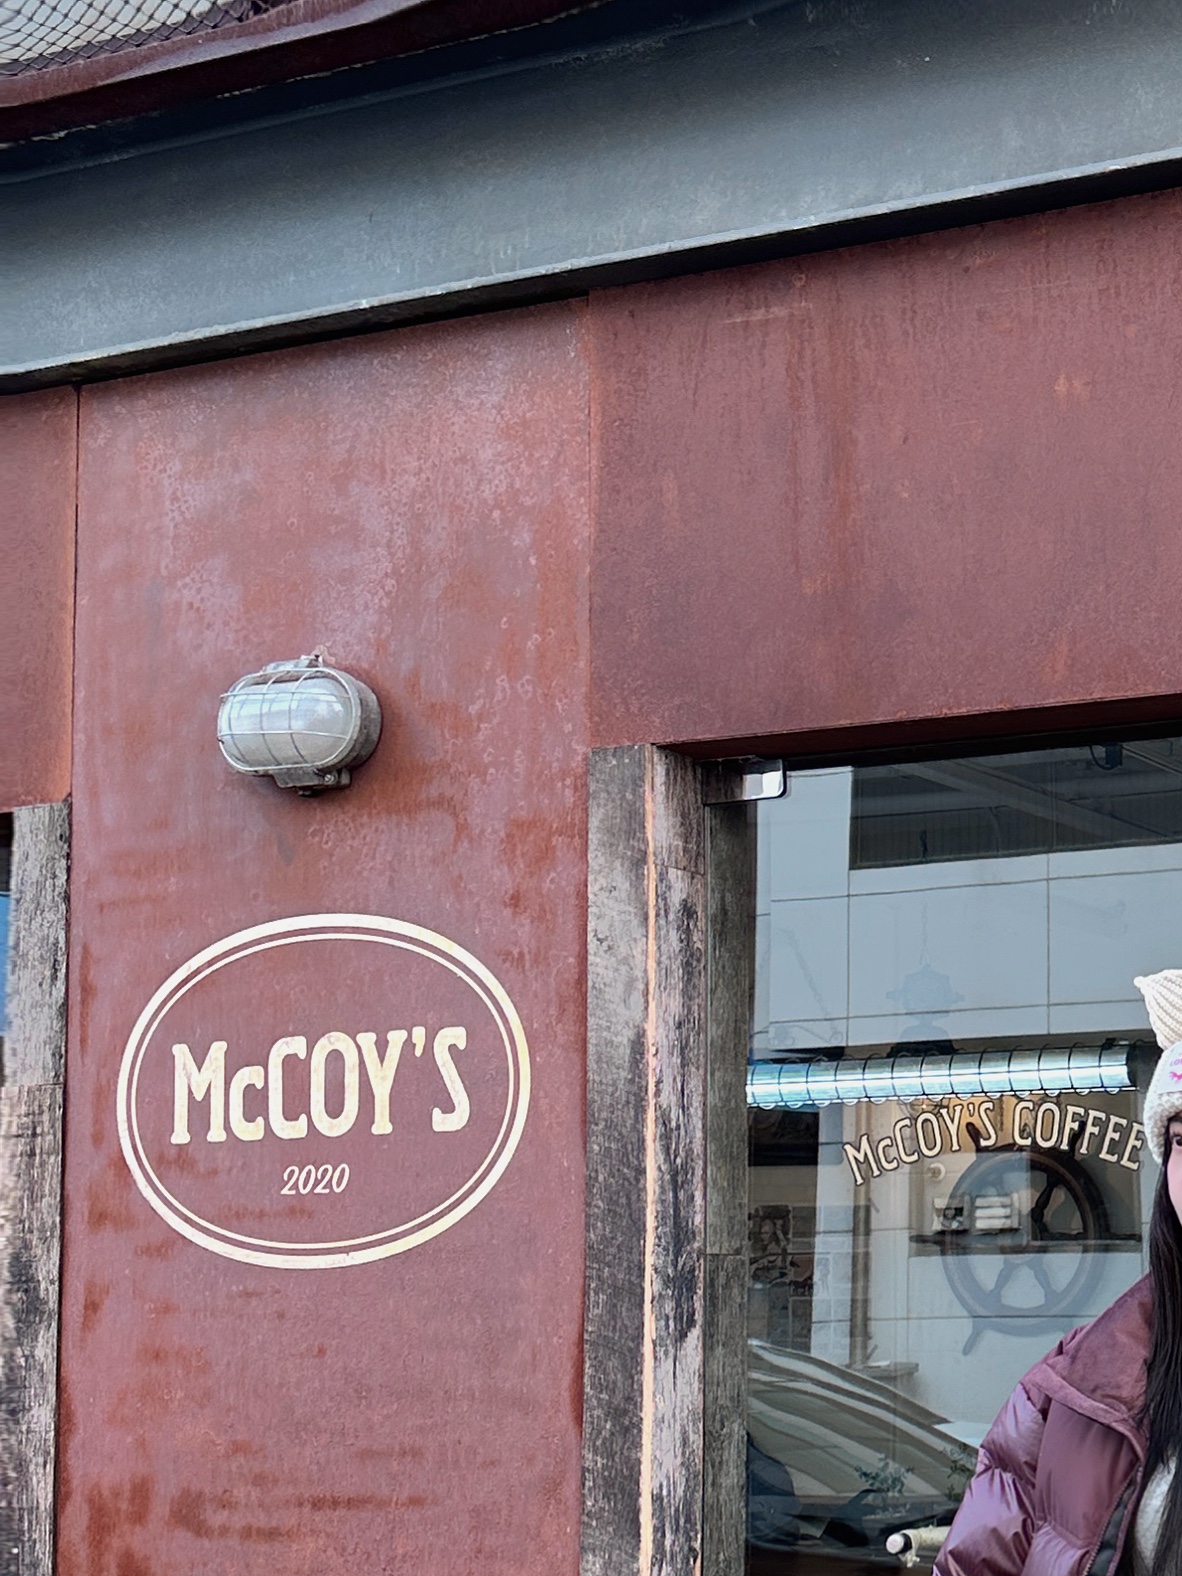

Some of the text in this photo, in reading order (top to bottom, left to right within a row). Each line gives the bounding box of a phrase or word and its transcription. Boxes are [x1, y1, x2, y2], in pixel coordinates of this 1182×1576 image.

[170, 1026, 471, 1145] McCOY'S
[280, 1163, 351, 1196] 2020
[843, 1101, 1145, 1187] McCOY'S COFFEE
